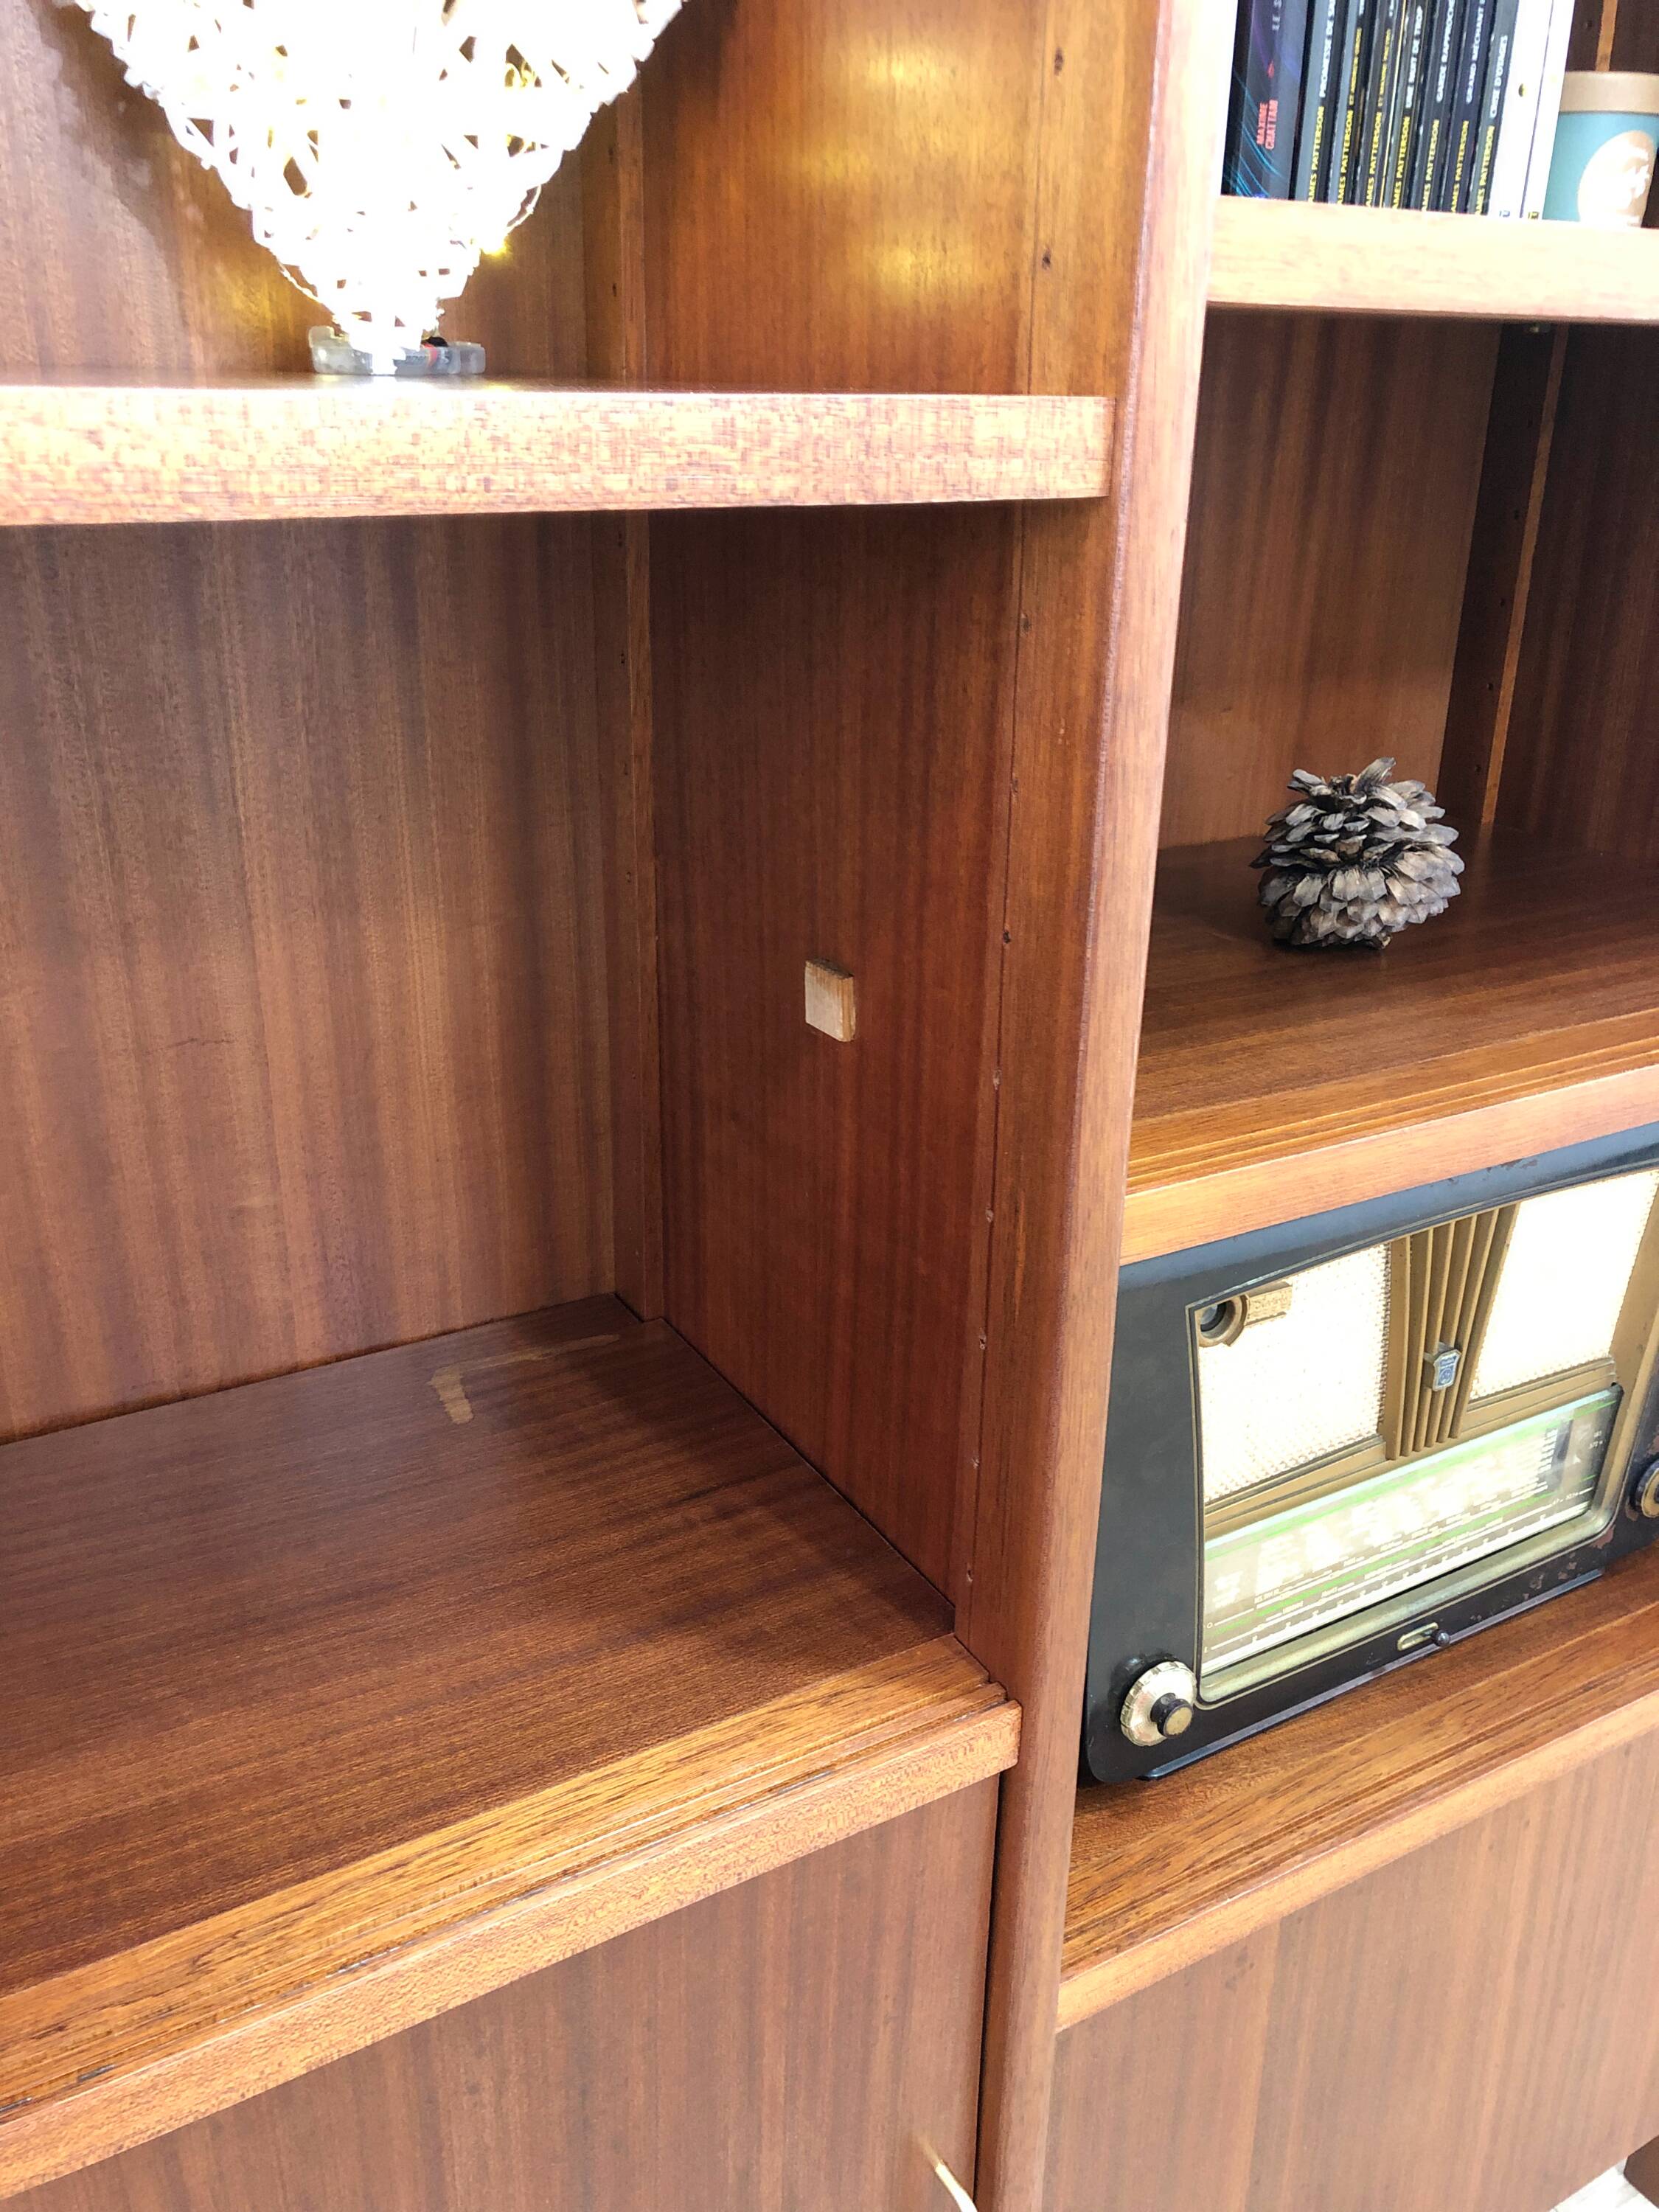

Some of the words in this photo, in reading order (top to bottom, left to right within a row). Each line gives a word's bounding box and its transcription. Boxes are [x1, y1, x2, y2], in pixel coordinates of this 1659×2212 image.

[1326, 19, 1335, 35] DE
[1414, 5, 1423, 35] TROP
[1412, 38, 1420, 55] DE
[1319, 38, 1332, 98] PROMESSE
[1408, 57, 1417, 83] NUIT
[1436, 64, 1447, 103] GARDE
[1466, 63, 1477, 104] GRAND
[1406, 85, 1415, 108] UNE
[1489, 88, 1500, 119] CRISE
[1256, 101, 1268, 145] MAXIME
[1265, 99, 1279, 150] CHATTAM
[1312, 105, 1325, 170] PATTERSON
[1340, 110, 1354, 173] PATTERSON
[1369, 112, 1382, 174] PATTERSON
[1397, 116, 1411, 178] PATTERSON
[1425, 119, 1440, 181] PATTERSON
[1455, 120, 1470, 181] PATTERSON
[1479, 125, 1495, 186] PATTERSON
[1308, 173, 1317, 203] AMES
[1338, 176, 1346, 205] AMES
[1366, 177, 1374, 207] AMES
[1393, 181, 1402, 209] AMES
[1422, 184, 1431, 212] AMES
[1451, 184, 1460, 213] AMES
[1475, 188, 1485, 215] AMES
